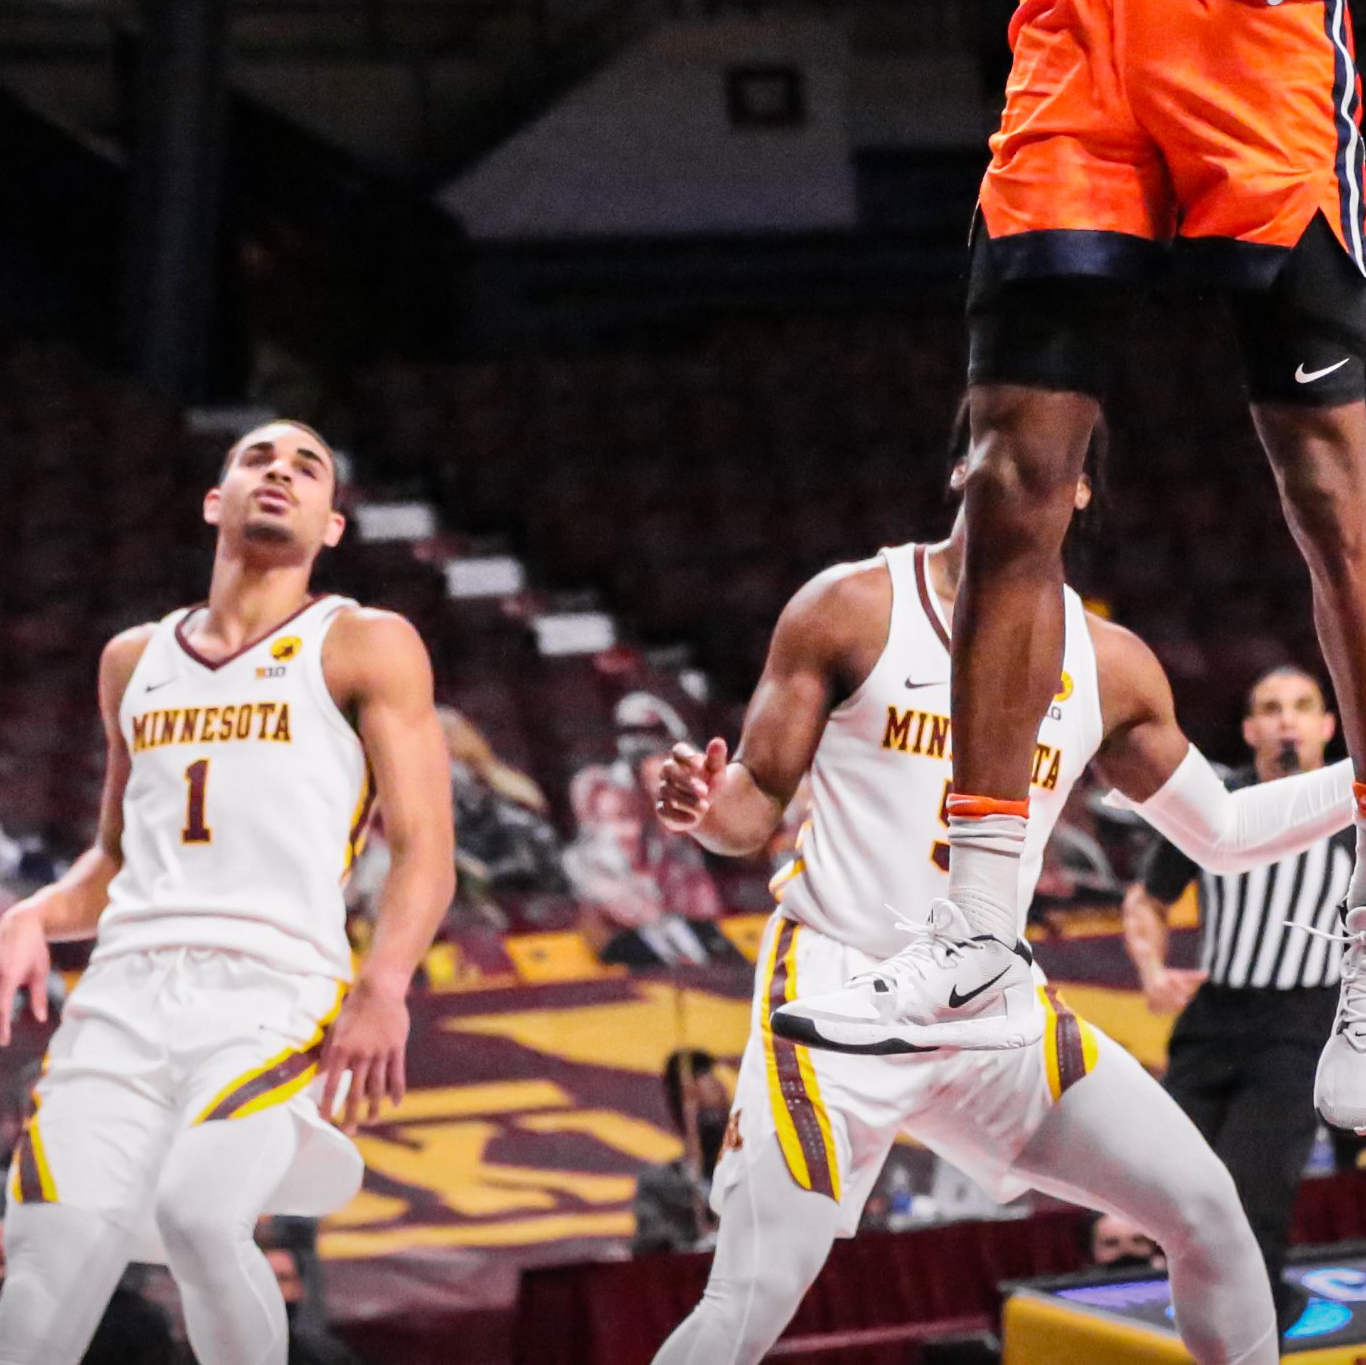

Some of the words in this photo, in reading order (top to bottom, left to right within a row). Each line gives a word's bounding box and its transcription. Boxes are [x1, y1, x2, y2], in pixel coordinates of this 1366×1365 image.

[132, 702, 292, 752] MINNESOTA
[882, 705, 1063, 790] MINTA
[181, 757, 211, 845] 1
